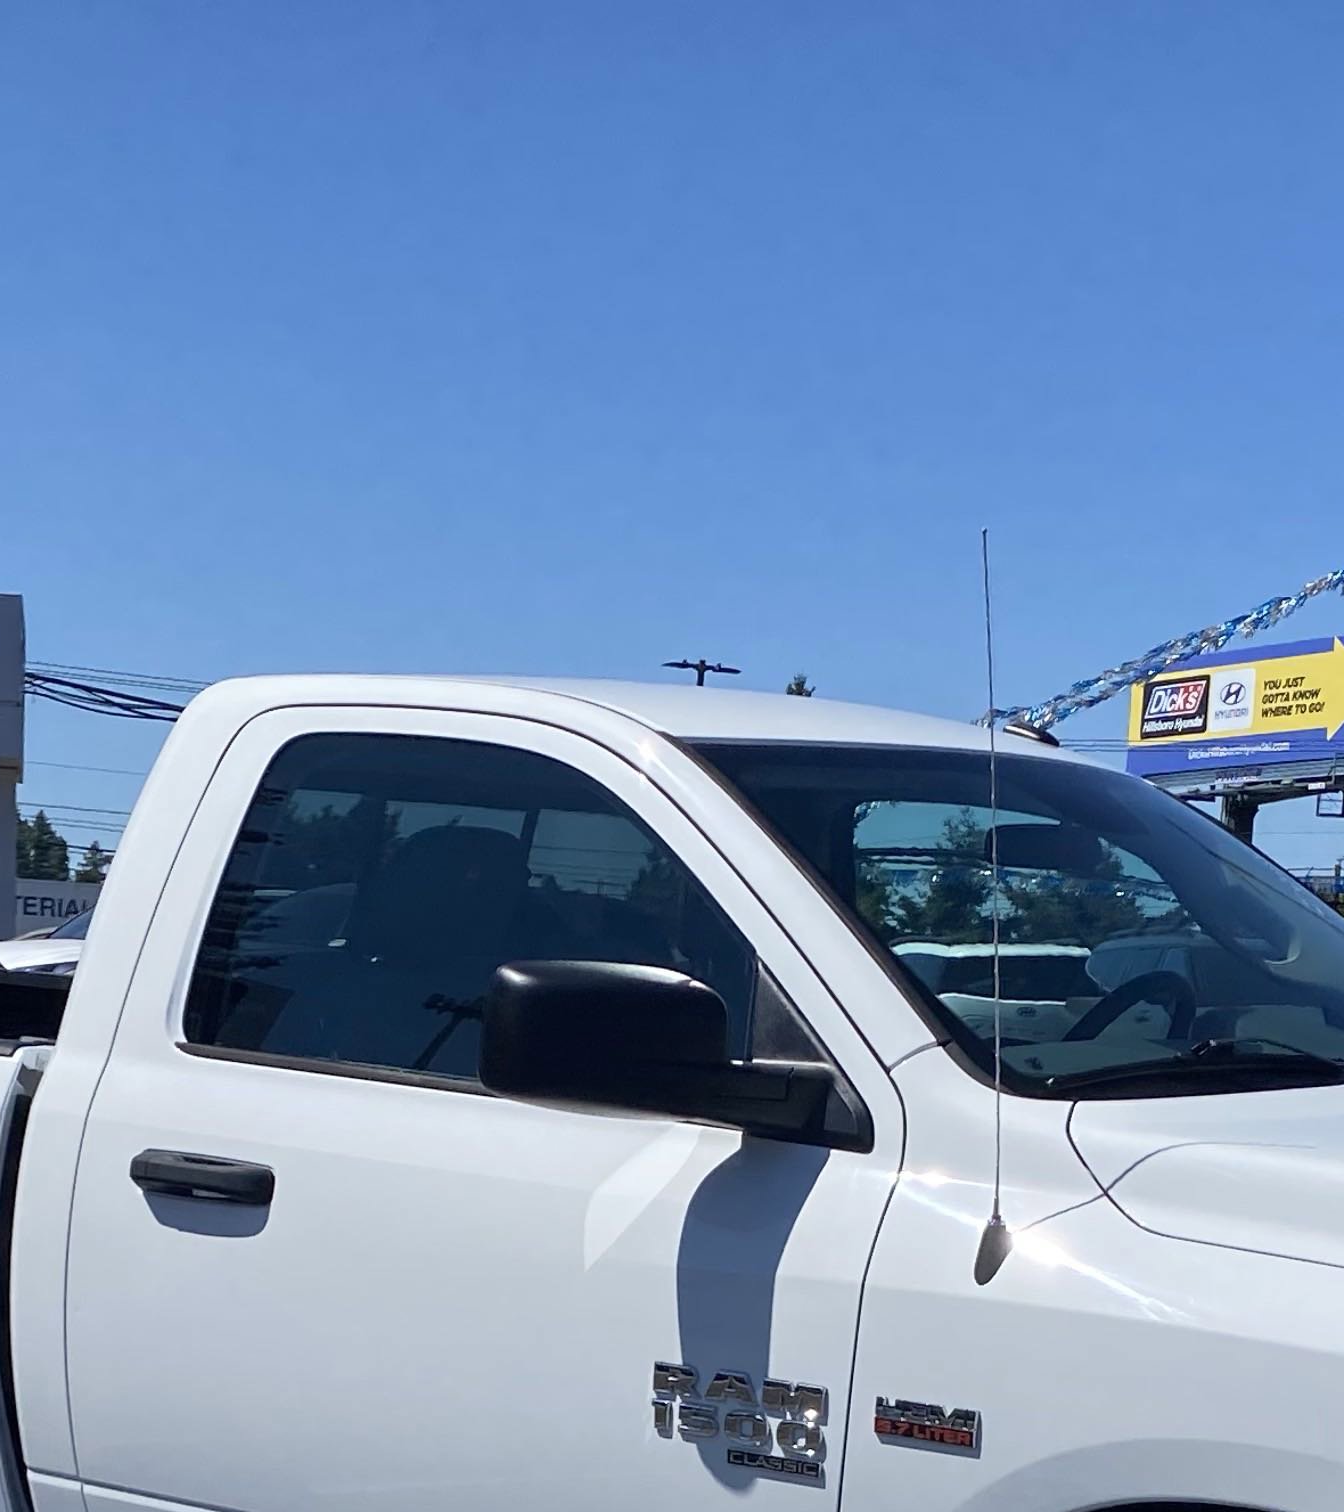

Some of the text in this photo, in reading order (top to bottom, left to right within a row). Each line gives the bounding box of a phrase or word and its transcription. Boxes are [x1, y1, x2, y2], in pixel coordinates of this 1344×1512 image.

[1264, 676, 1306, 691] YOU JUST
[1261, 688, 1322, 704] GOTTA KNOW
[1215, 707, 1249, 720] HYUNDAI
[1261, 702, 1326, 718] WHERE TO GO!
[1143, 714, 1205, 733] Hillsboro Hyundai
[652, 1361, 827, 1421] RAM
[652, 1398, 824, 1455] 1500
[875, 1418, 972, 1446] 5.7 LITER
[729, 1450, 820, 1477] CLASSIC
